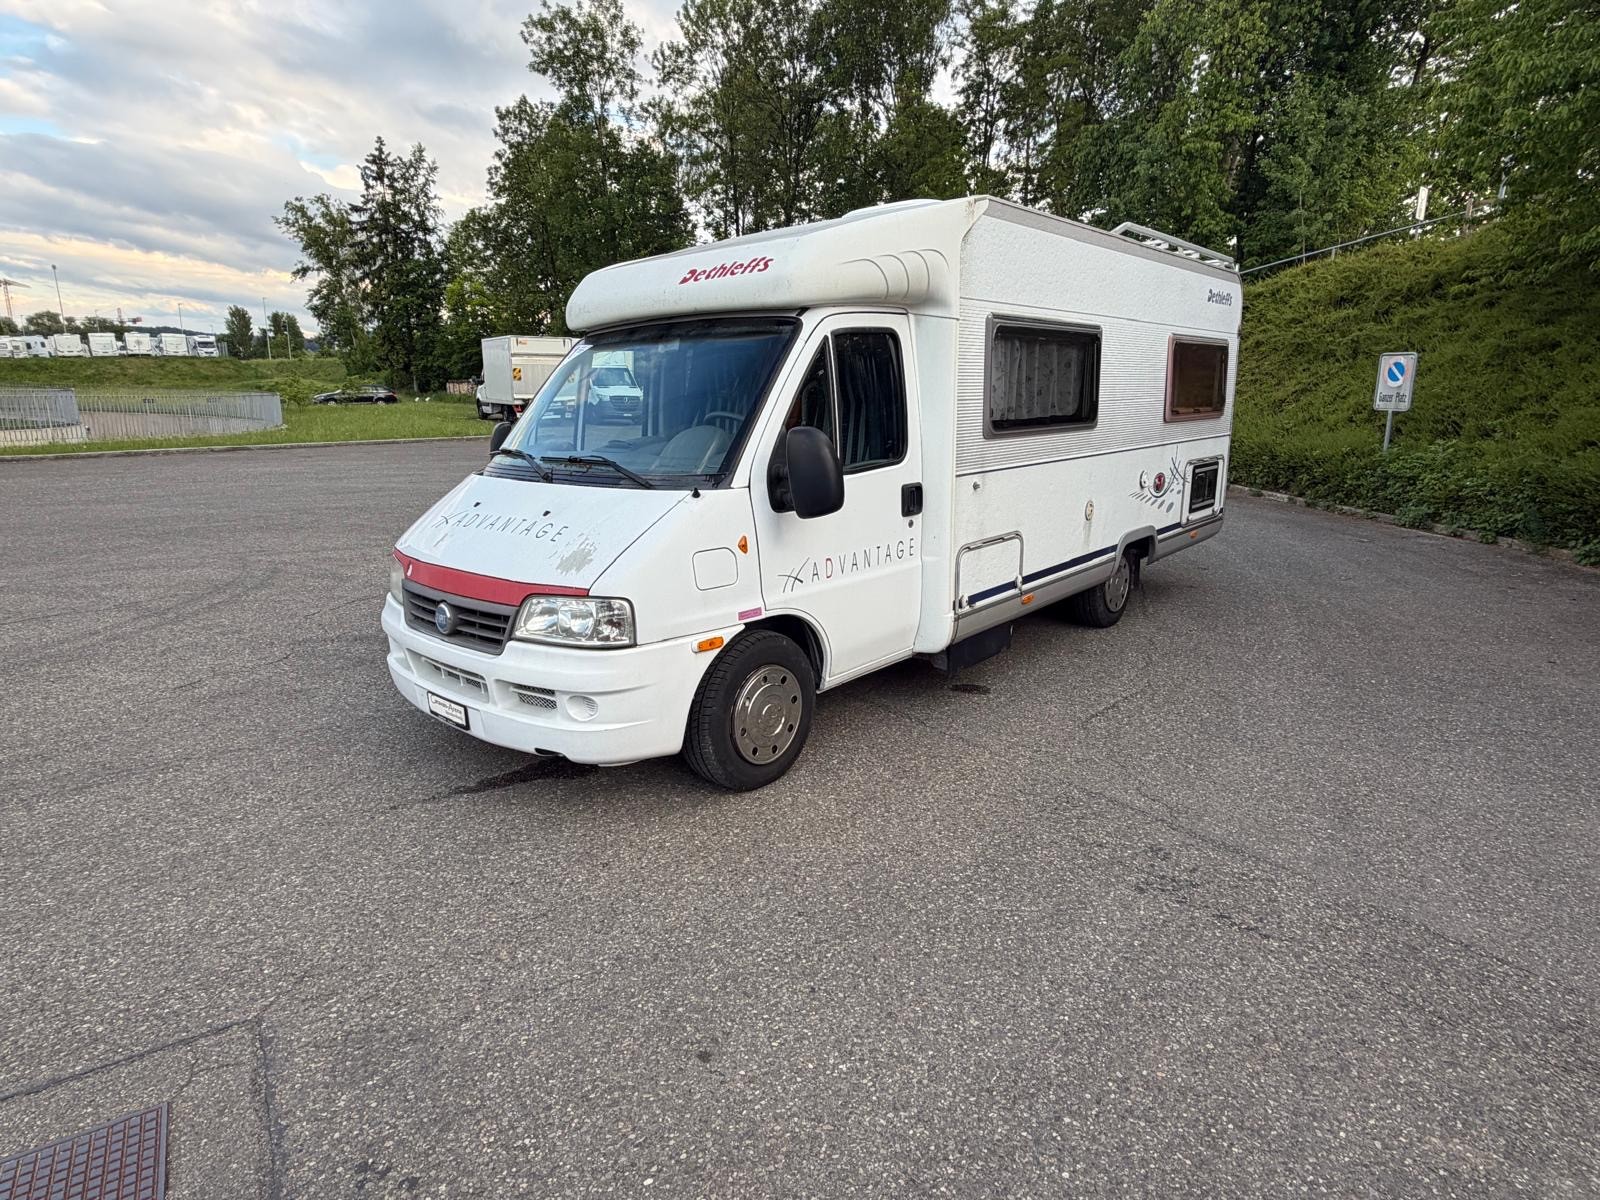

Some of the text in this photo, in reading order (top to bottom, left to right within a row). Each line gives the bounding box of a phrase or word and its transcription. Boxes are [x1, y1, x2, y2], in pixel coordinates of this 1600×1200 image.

[1395, 391, 1407, 403] Platz
[454, 512, 569, 542] ADVANTAGE
[811, 537, 915, 583] ADVANTAGE
